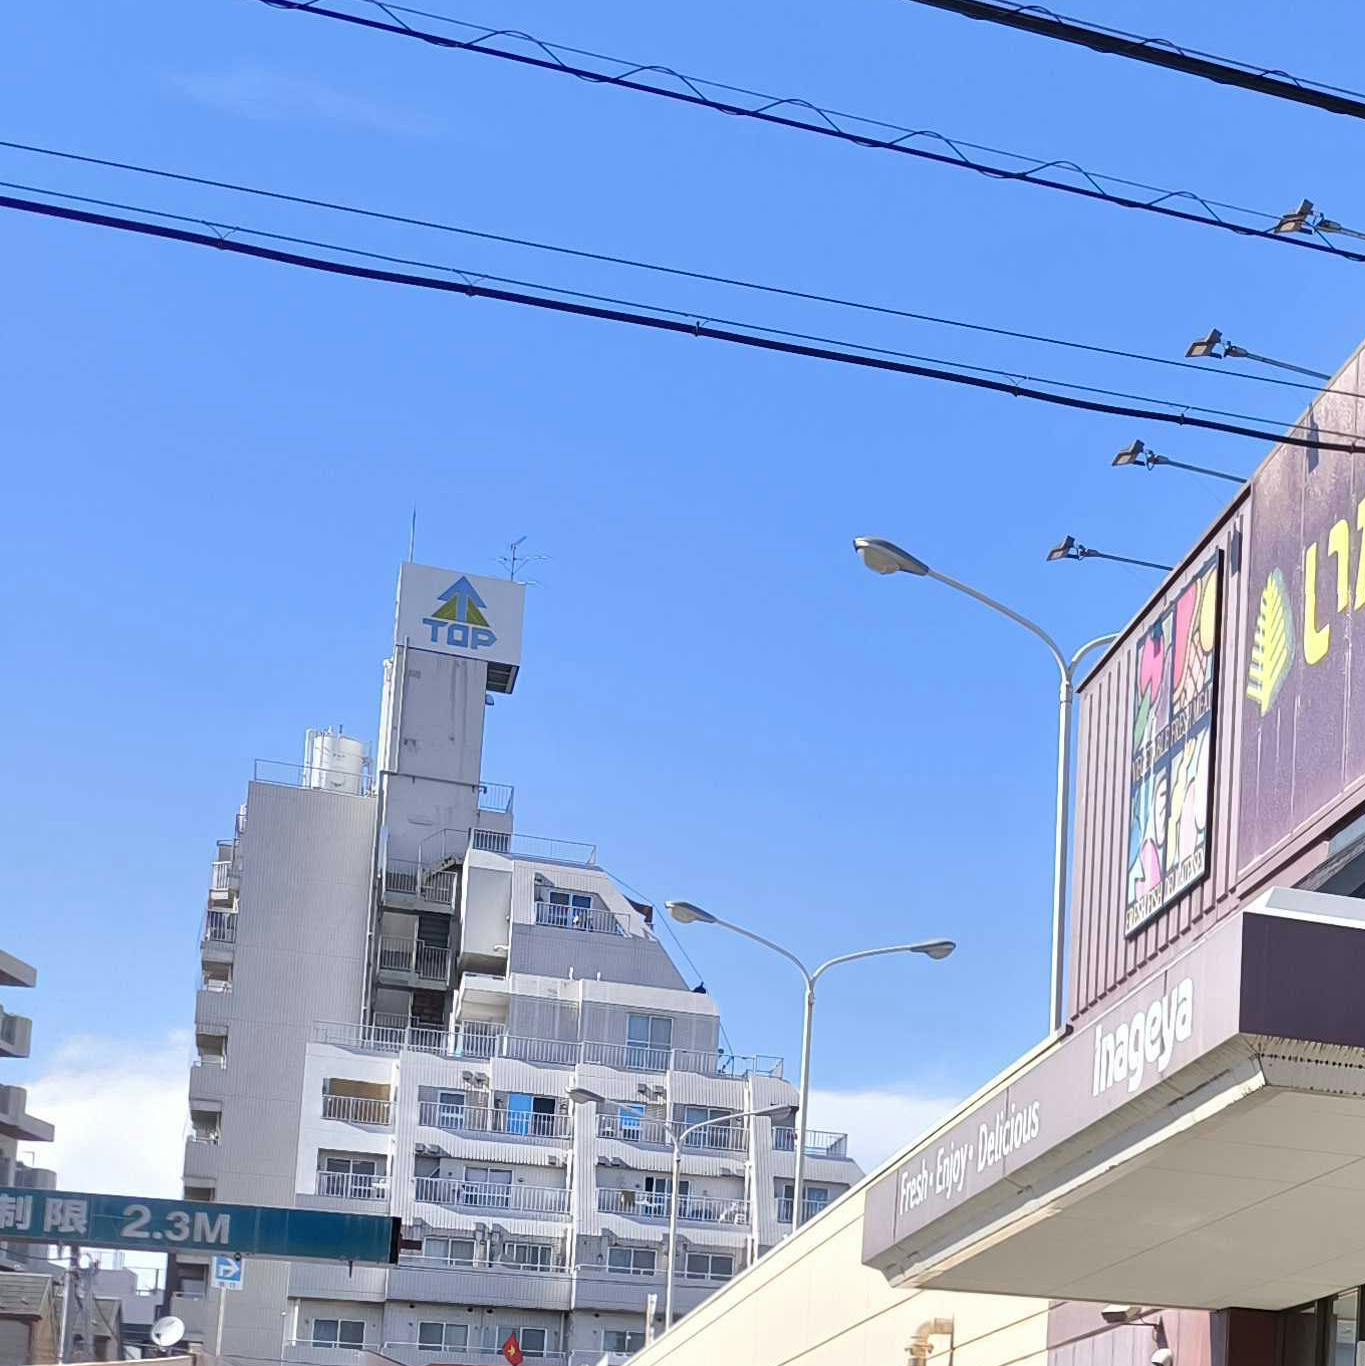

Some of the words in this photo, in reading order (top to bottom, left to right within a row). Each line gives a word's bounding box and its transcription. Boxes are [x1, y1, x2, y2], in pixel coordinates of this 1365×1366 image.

[422, 617, 498, 650] TOP
[899, 1159, 928, 1214] Fresh
[935, 1141, 969, 1200] Enjoy
[977, 1101, 1041, 1172] Delicious
[121, 1204, 230, 1244] 2.3M
